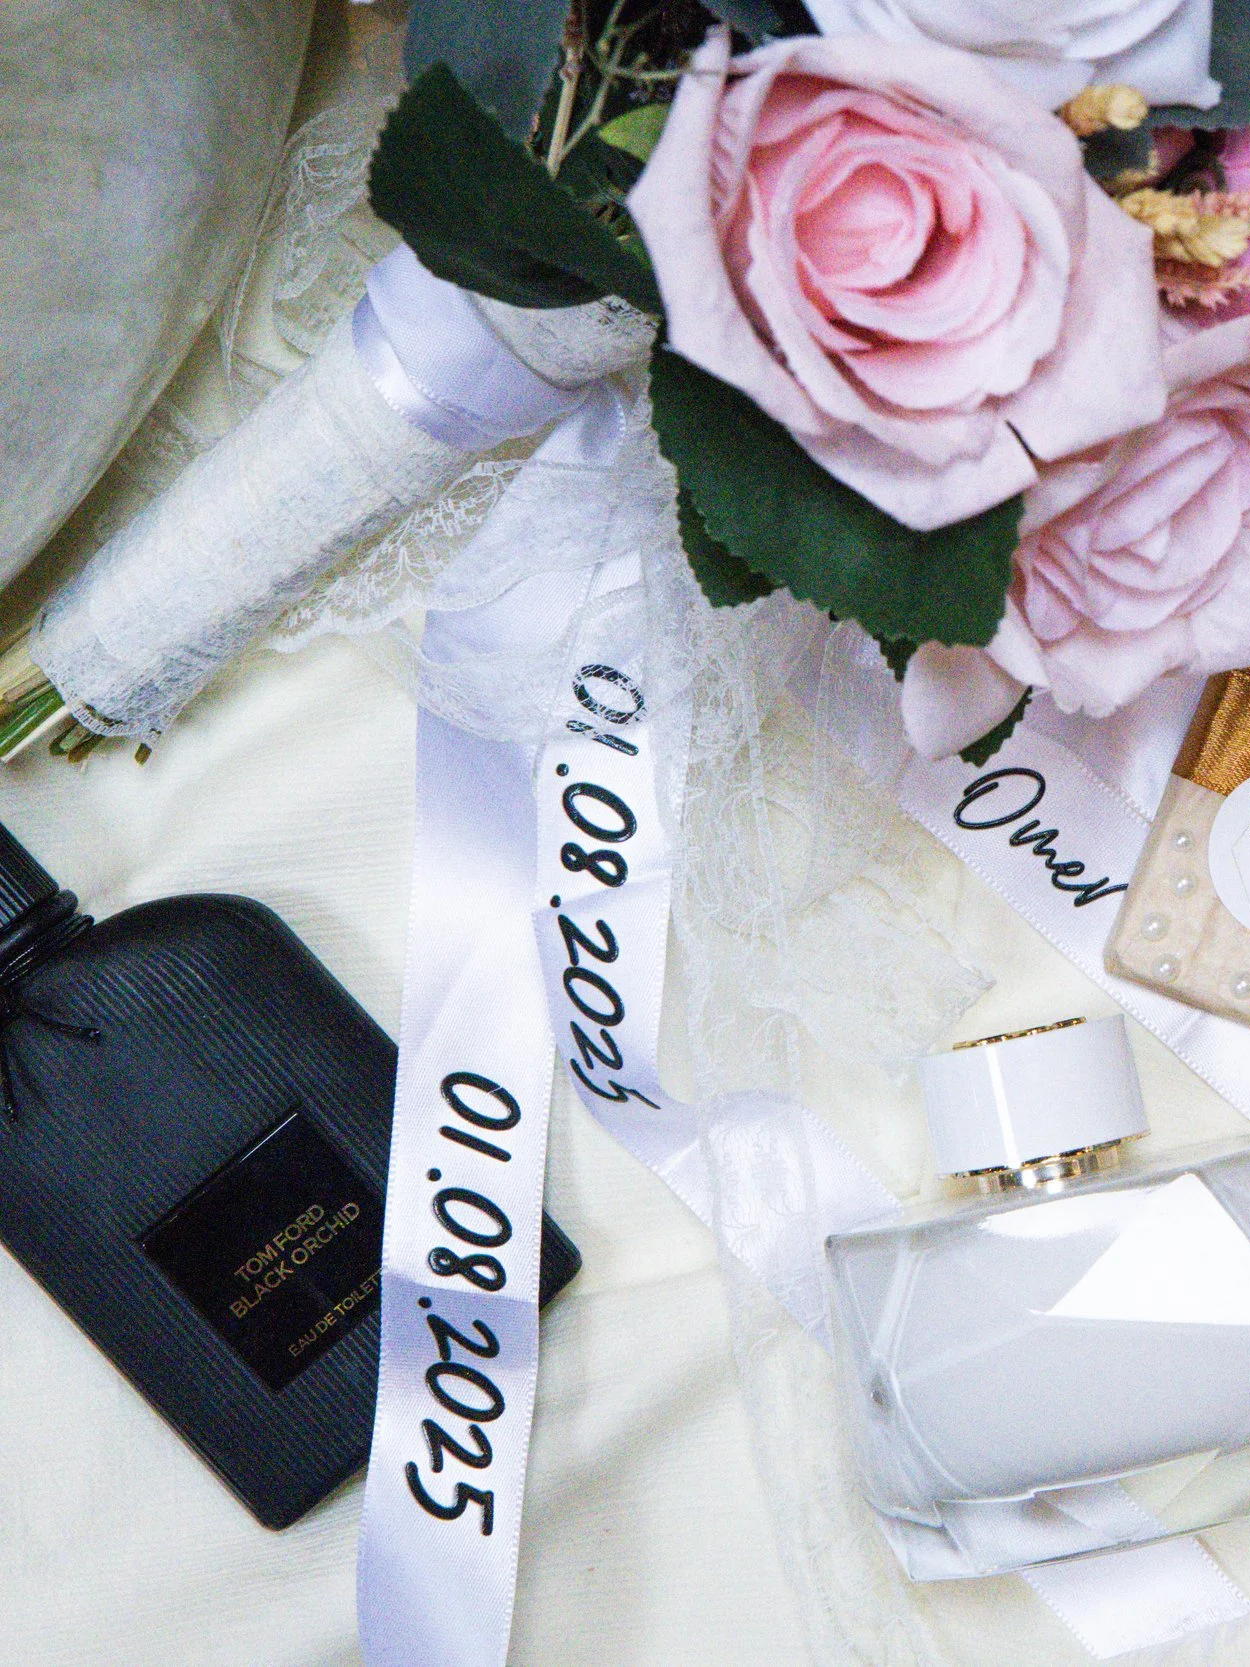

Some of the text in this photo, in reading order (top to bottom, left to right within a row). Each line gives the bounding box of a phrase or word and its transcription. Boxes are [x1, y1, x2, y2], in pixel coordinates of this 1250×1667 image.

[550, 664, 661, 1110] 01.08.2025
[228, 1201, 361, 1319] BLACK ORCHID
[233, 1203, 326, 1282] TOM FORD
[287, 1266, 383, 1358] EAU DE TOILET
[404, 1071, 521, 1537] 01.08.2025
